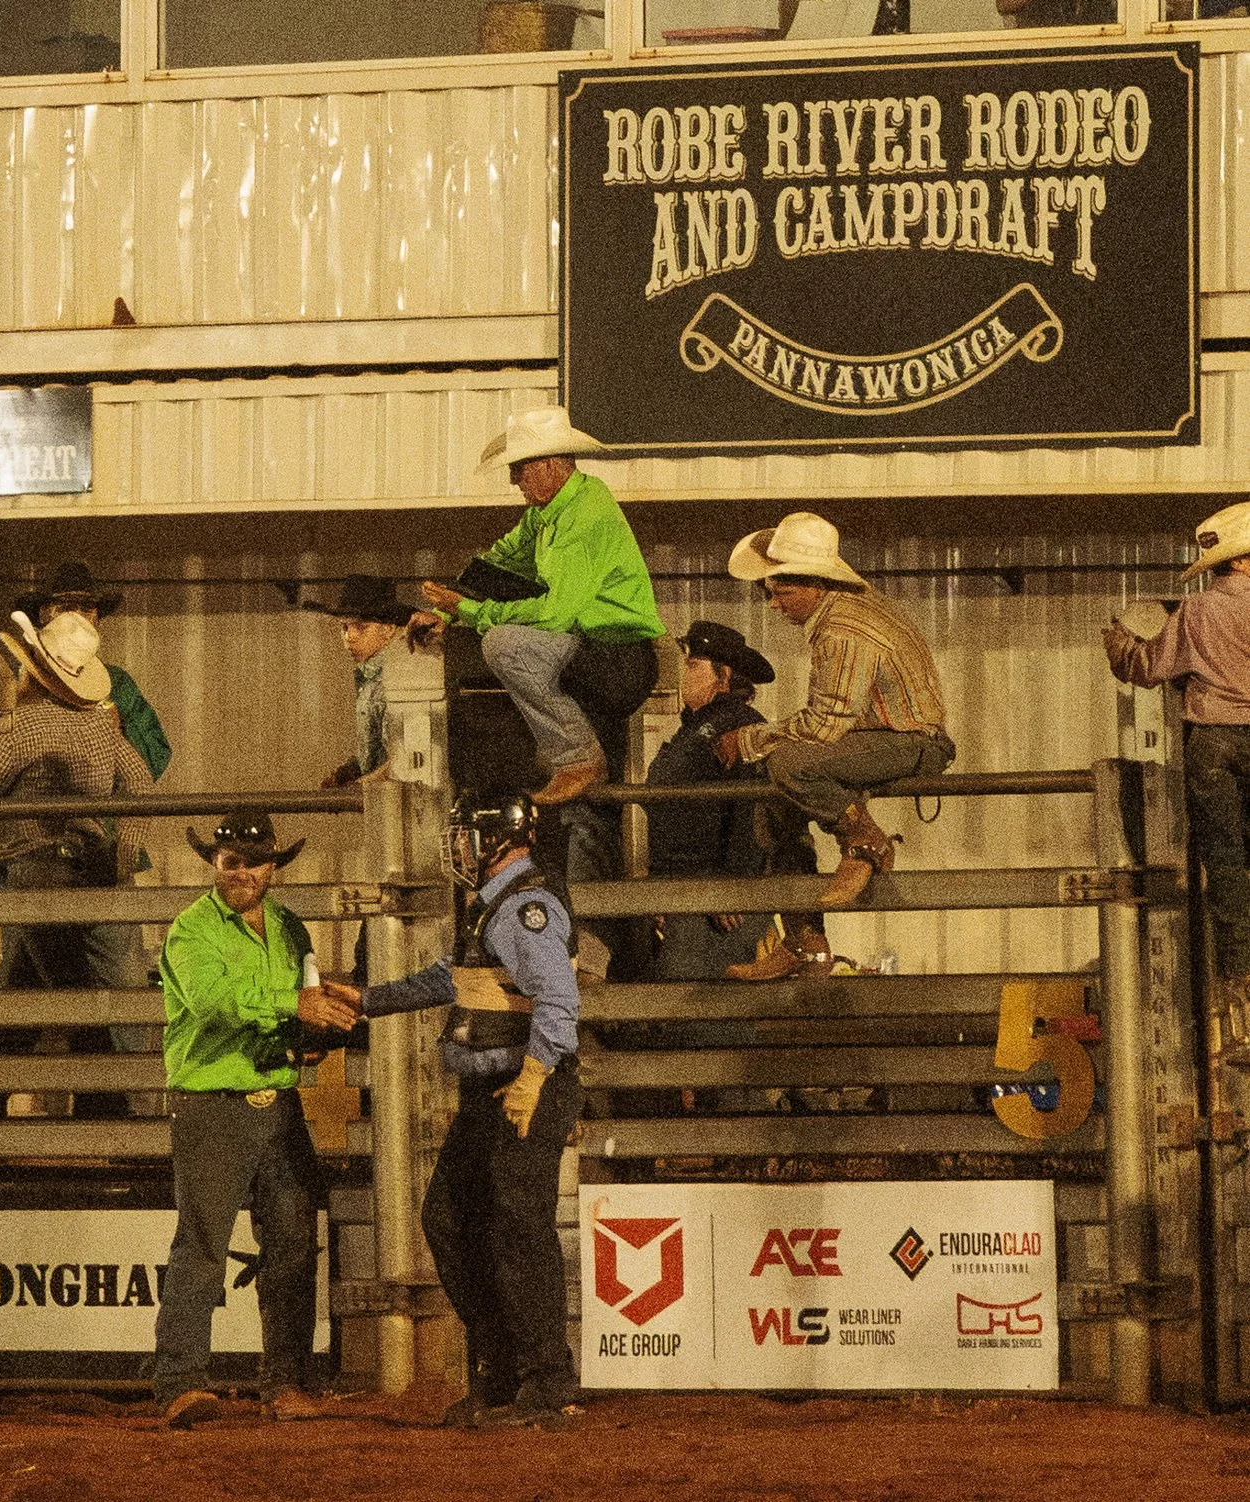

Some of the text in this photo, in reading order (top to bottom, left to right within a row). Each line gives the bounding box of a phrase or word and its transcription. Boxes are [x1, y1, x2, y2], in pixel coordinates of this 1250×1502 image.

[603, 85, 1150, 184] ROBE RIVER RODEO
[646, 175, 1107, 300] AND CAMPDRAFT
[727, 317, 1016, 401] PANNAWONICA
[992, 978, 1095, 1140] 5
[750, 1228, 843, 1276] ACE
[939, 1232, 1042, 1256] ENDURACLAD
[748, 1307, 831, 1346] WLS
[838, 1309, 902, 1326] WEAR LINER
[838, 1329, 896, 1346] SOLUTIONS
[598, 1333, 681, 1357] ACE GROUP
